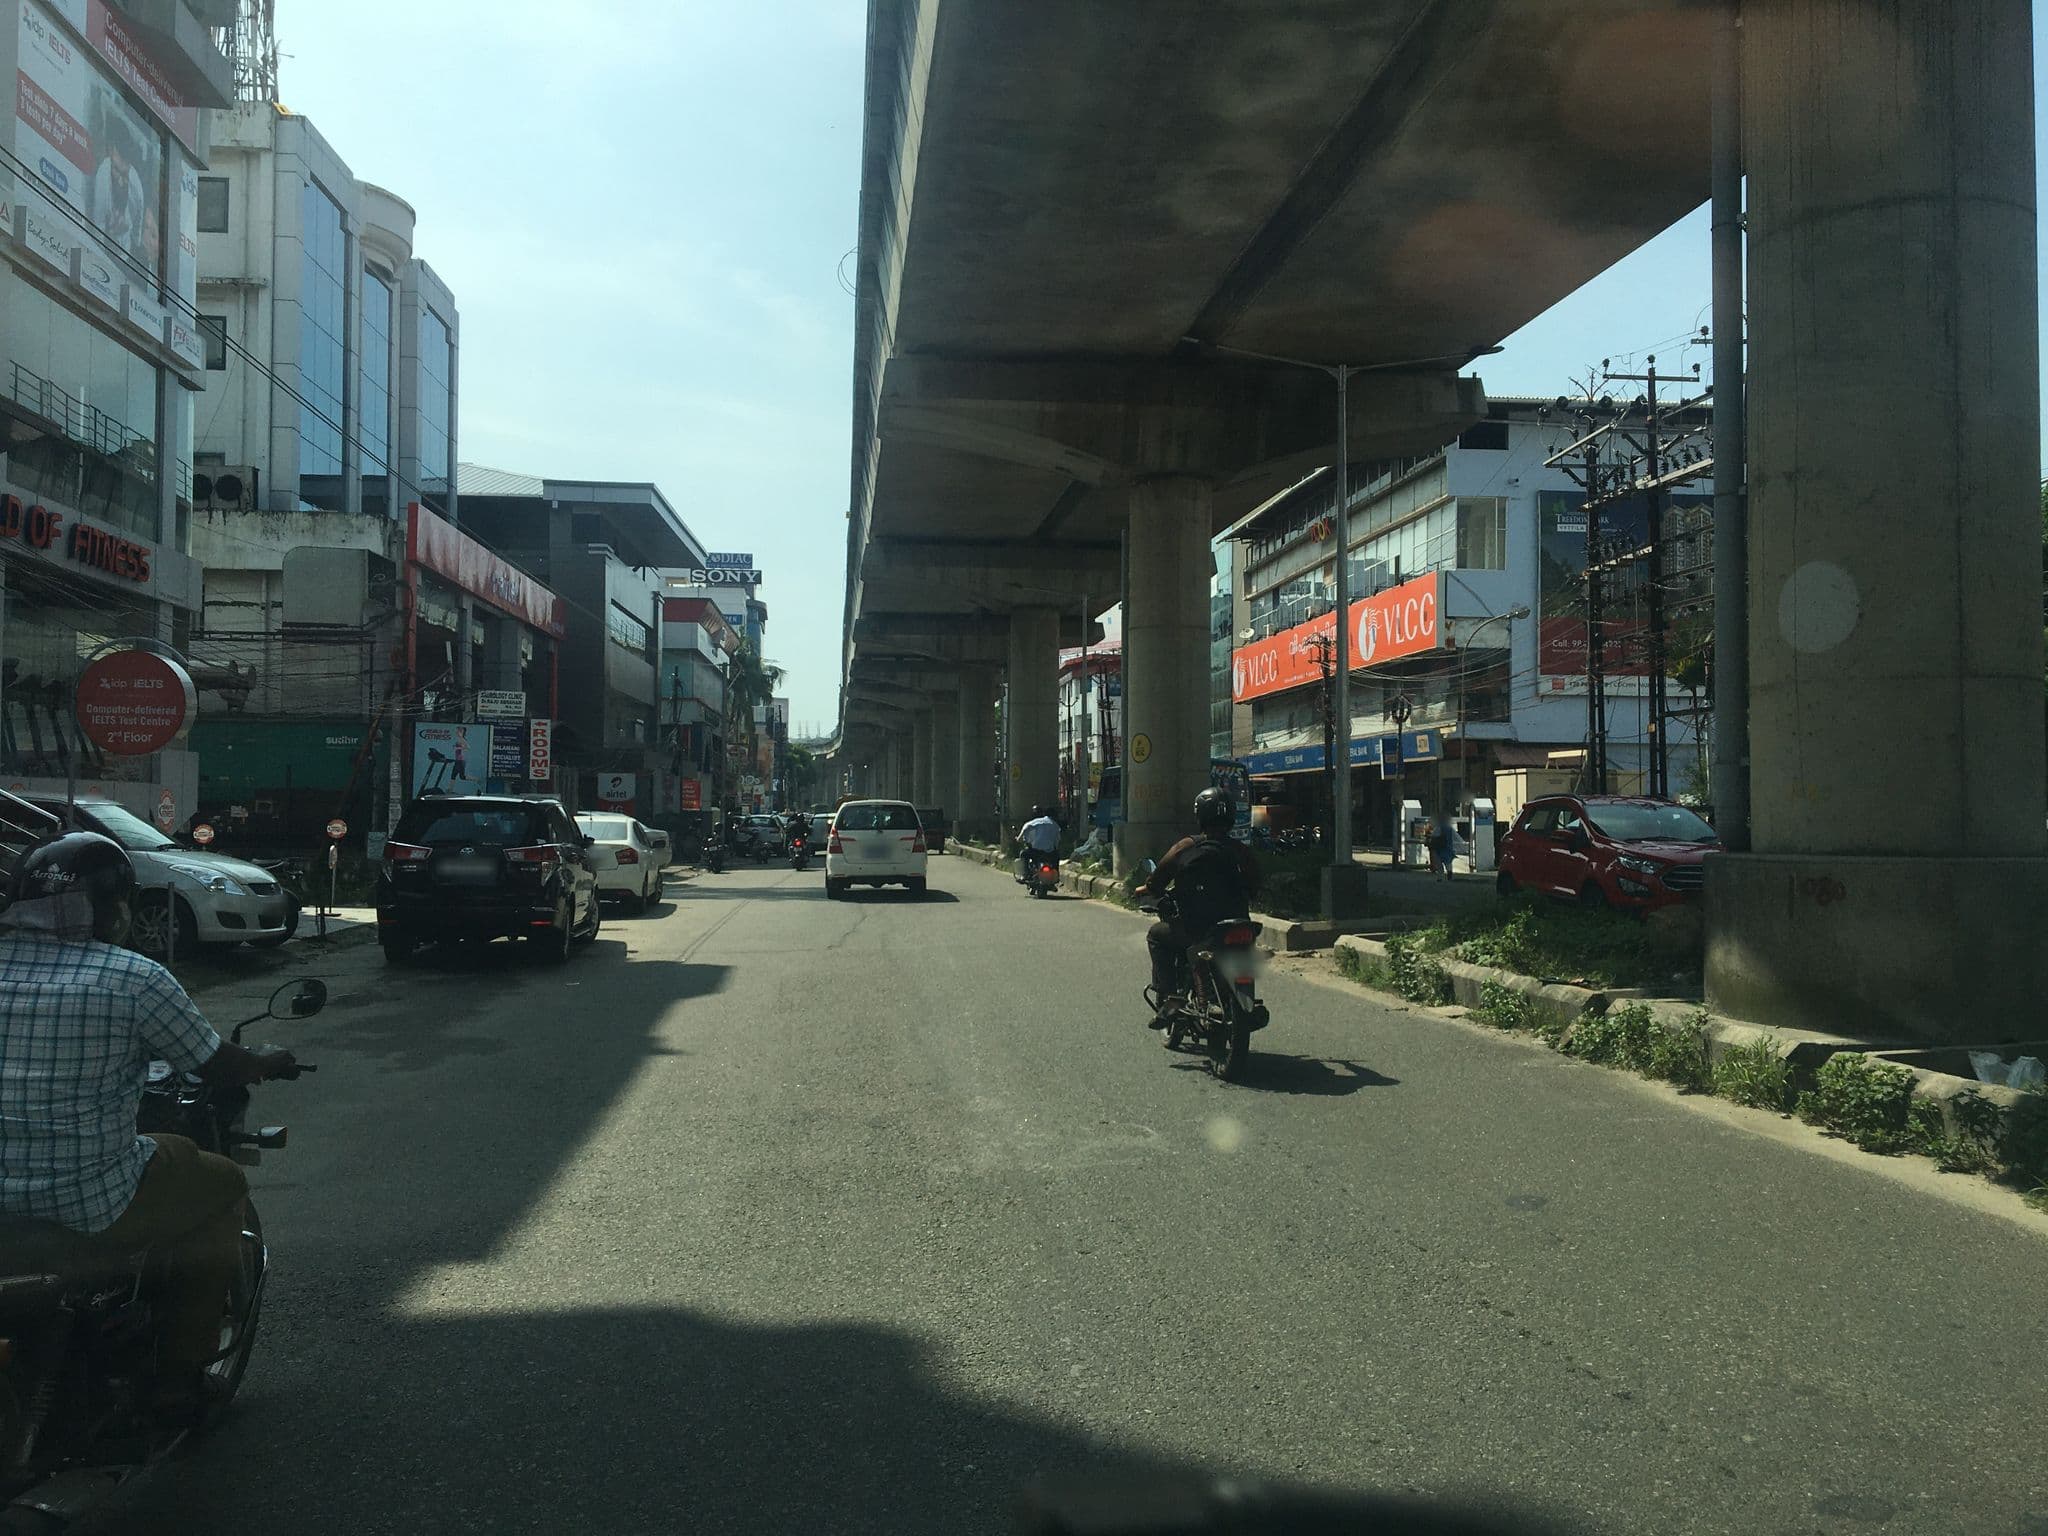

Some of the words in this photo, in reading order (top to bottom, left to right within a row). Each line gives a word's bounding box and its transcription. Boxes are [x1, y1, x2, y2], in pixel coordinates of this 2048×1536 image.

[105, 35, 131, 75] IELTS
[131, 68, 149, 93] Test
[150, 87, 176, 125] Centre
[30, 504, 63, 549] OF
[75, 522, 151, 583] FITNESS
[691, 569, 759, 583] SONY
[1384, 592, 1434, 646] VLCC
[1248, 649, 1278, 688] VLCC
[133, 679, 164, 689] IELTS
[86, 704, 177, 715] Computer-delivered
[91, 715, 116, 725] IELTS
[119, 716, 137, 725] Test
[140, 716, 171, 726] Centre
[123, 731, 153, 743] Floor
[531, 728, 549, 778] ROOMS
[606, 790, 627, 798] airtel
